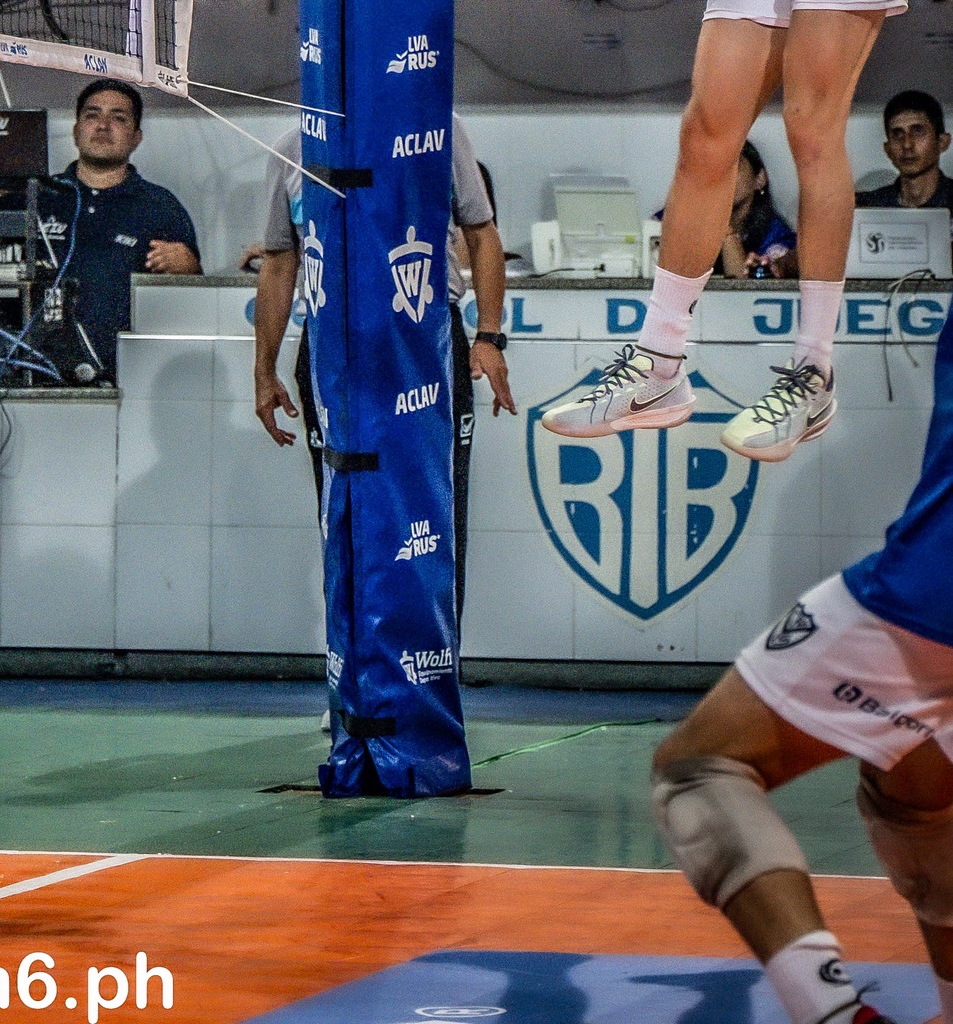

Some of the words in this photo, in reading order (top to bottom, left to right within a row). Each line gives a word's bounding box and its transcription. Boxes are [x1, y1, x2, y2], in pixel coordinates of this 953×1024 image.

[408, 35, 429, 52] LVA
[84, 54, 108, 74] ACLAV
[408, 51, 438, 71] RUS
[392, 129, 445, 158] ACLAV
[395, 382, 440, 415] ACLAV
[411, 519, 430, 538] LVA
[413, 535, 439, 557] RUS
[415, 647, 453, 669] Wolfi
